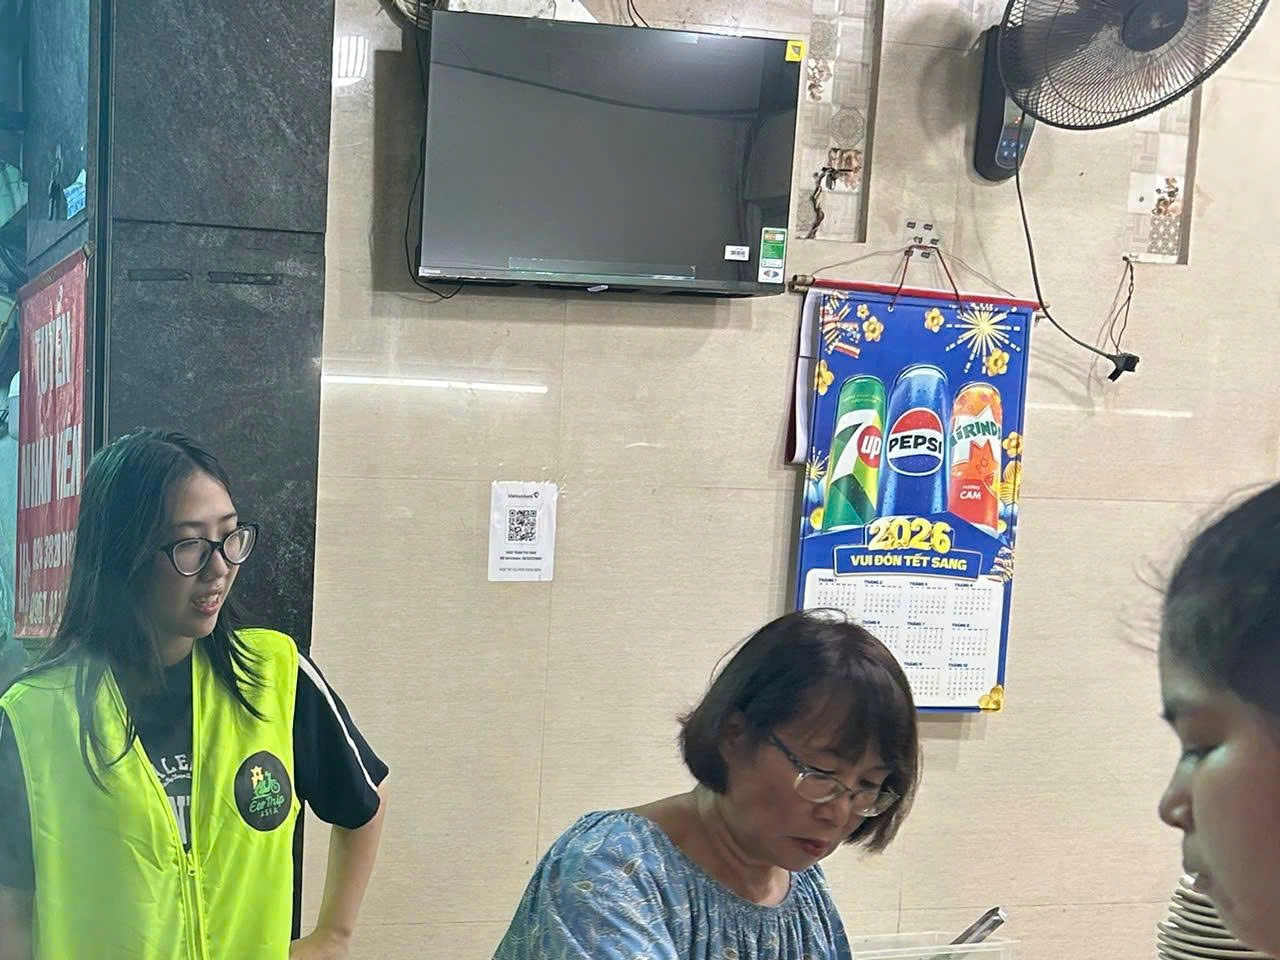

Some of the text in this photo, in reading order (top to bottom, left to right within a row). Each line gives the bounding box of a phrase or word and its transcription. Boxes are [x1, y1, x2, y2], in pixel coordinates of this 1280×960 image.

[889, 435, 942, 454] PEPSI
[959, 490, 981, 500] CAM
[868, 517, 951, 554] 2026
[850, 551, 967, 571] VUI ĐÓN TẾT SANG
